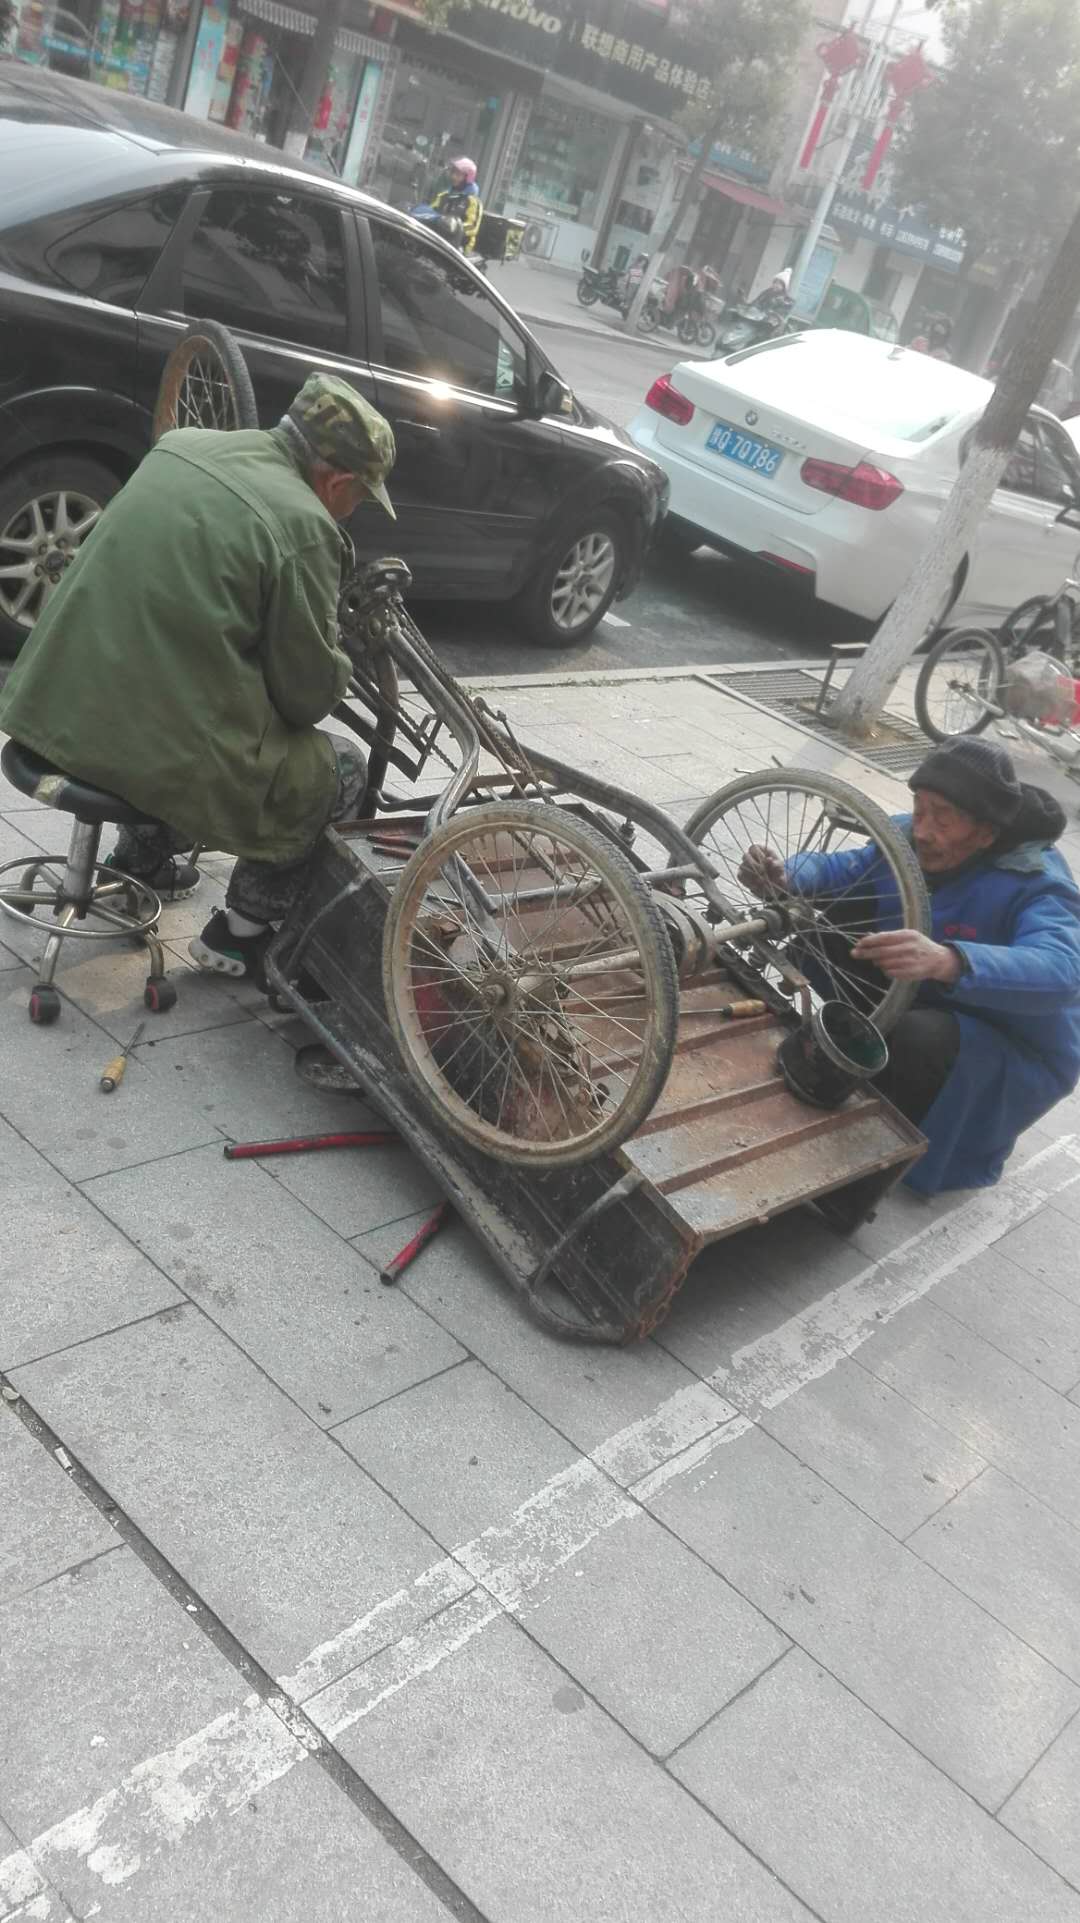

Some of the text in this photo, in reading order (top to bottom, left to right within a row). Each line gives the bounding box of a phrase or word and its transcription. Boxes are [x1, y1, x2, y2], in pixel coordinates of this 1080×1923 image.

[580, 23, 713, 101] 联想商用产品体验店
